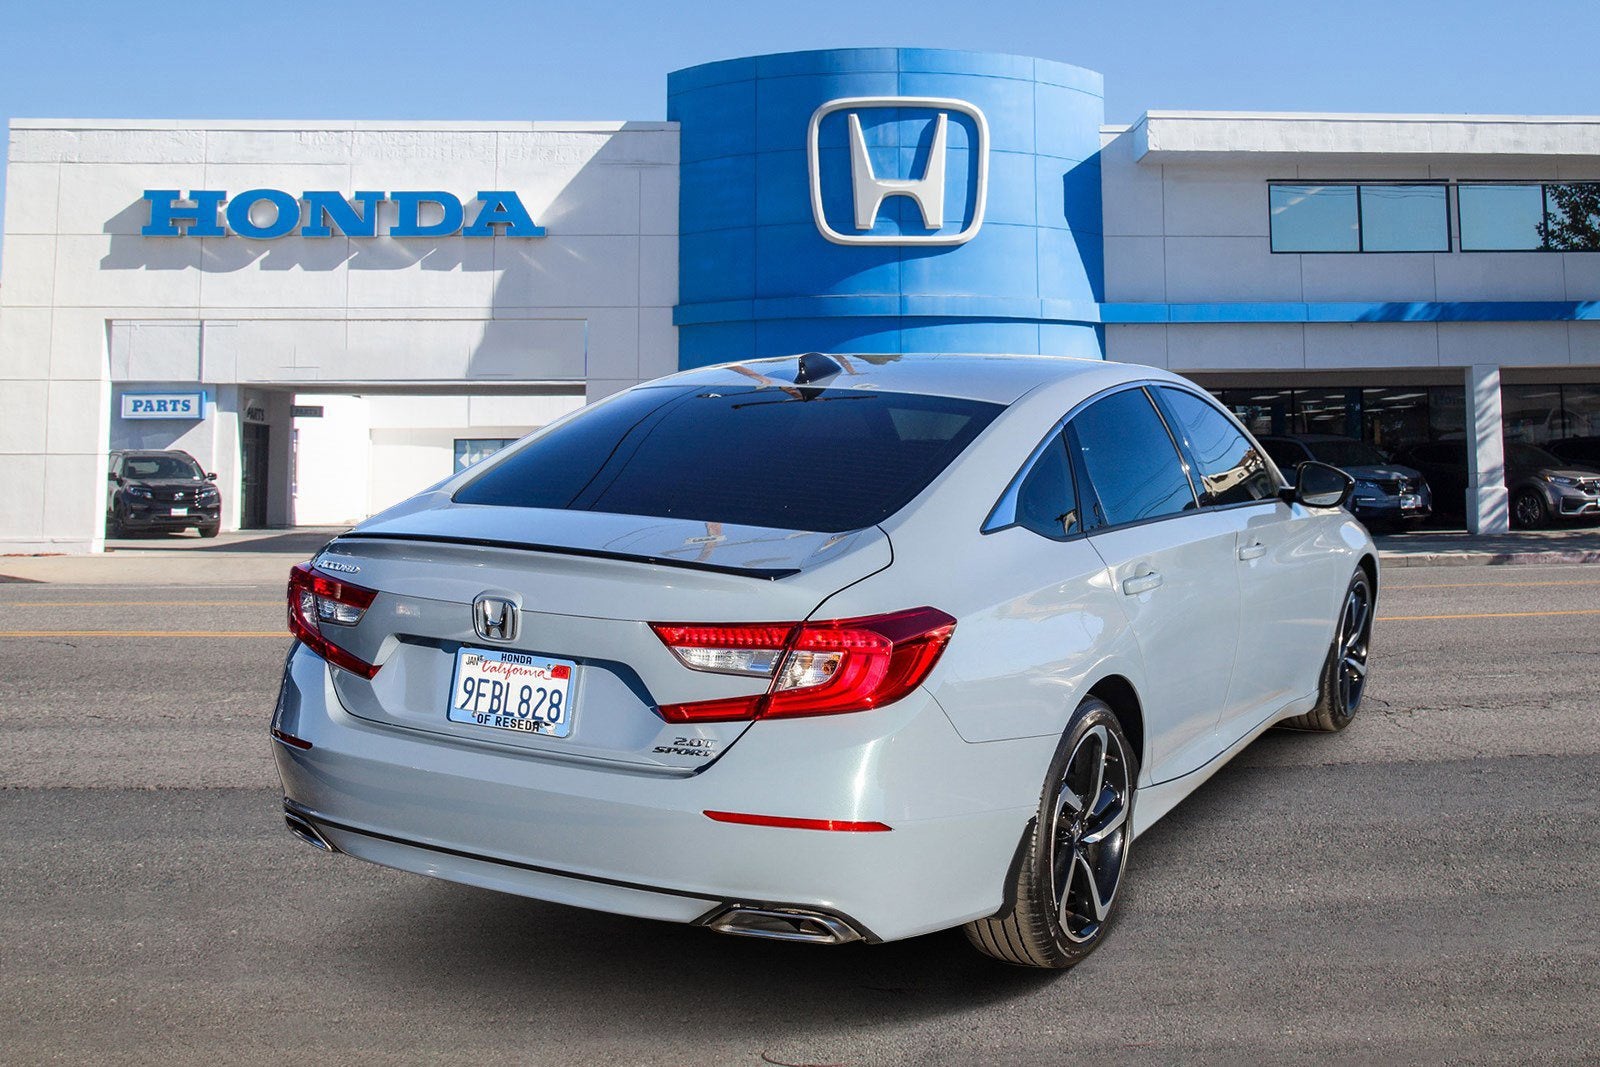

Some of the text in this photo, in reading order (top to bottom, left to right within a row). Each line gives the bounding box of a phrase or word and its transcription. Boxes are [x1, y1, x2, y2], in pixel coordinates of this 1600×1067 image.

[141, 188, 547, 239] HONDA
[132, 399, 191, 413] PARTS
[318, 560, 361, 574] ACCORD
[501, 653, 533, 665] HONDA
[480, 660, 553, 681] California
[460, 676, 563, 723] 9FBL828
[477, 713, 540, 732] OF RESEDA
[673, 736, 718, 748] 2.0T
[652, 746, 716, 757] SPORT
